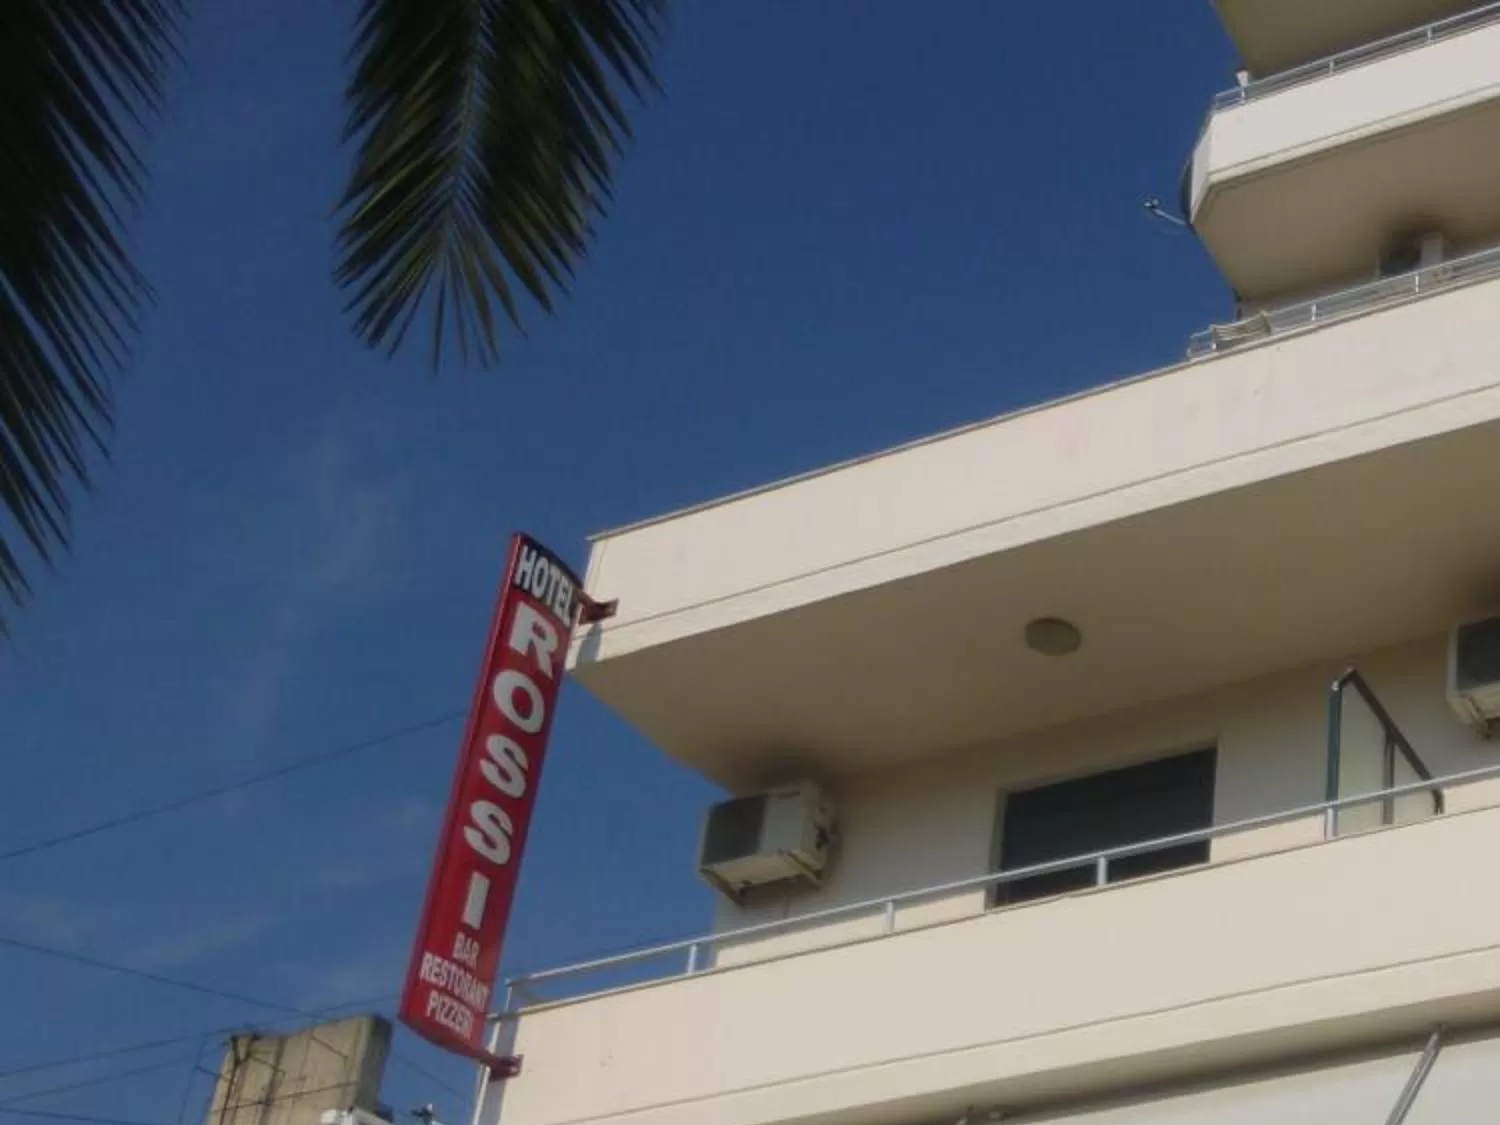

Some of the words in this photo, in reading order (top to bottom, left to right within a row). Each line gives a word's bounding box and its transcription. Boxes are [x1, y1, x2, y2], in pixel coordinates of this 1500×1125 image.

[515, 545, 574, 628] HOTEL
[462, 602, 559, 929] ROSSI
[419, 951, 489, 1013] RESTORANT
[452, 931, 480, 970] BAR
